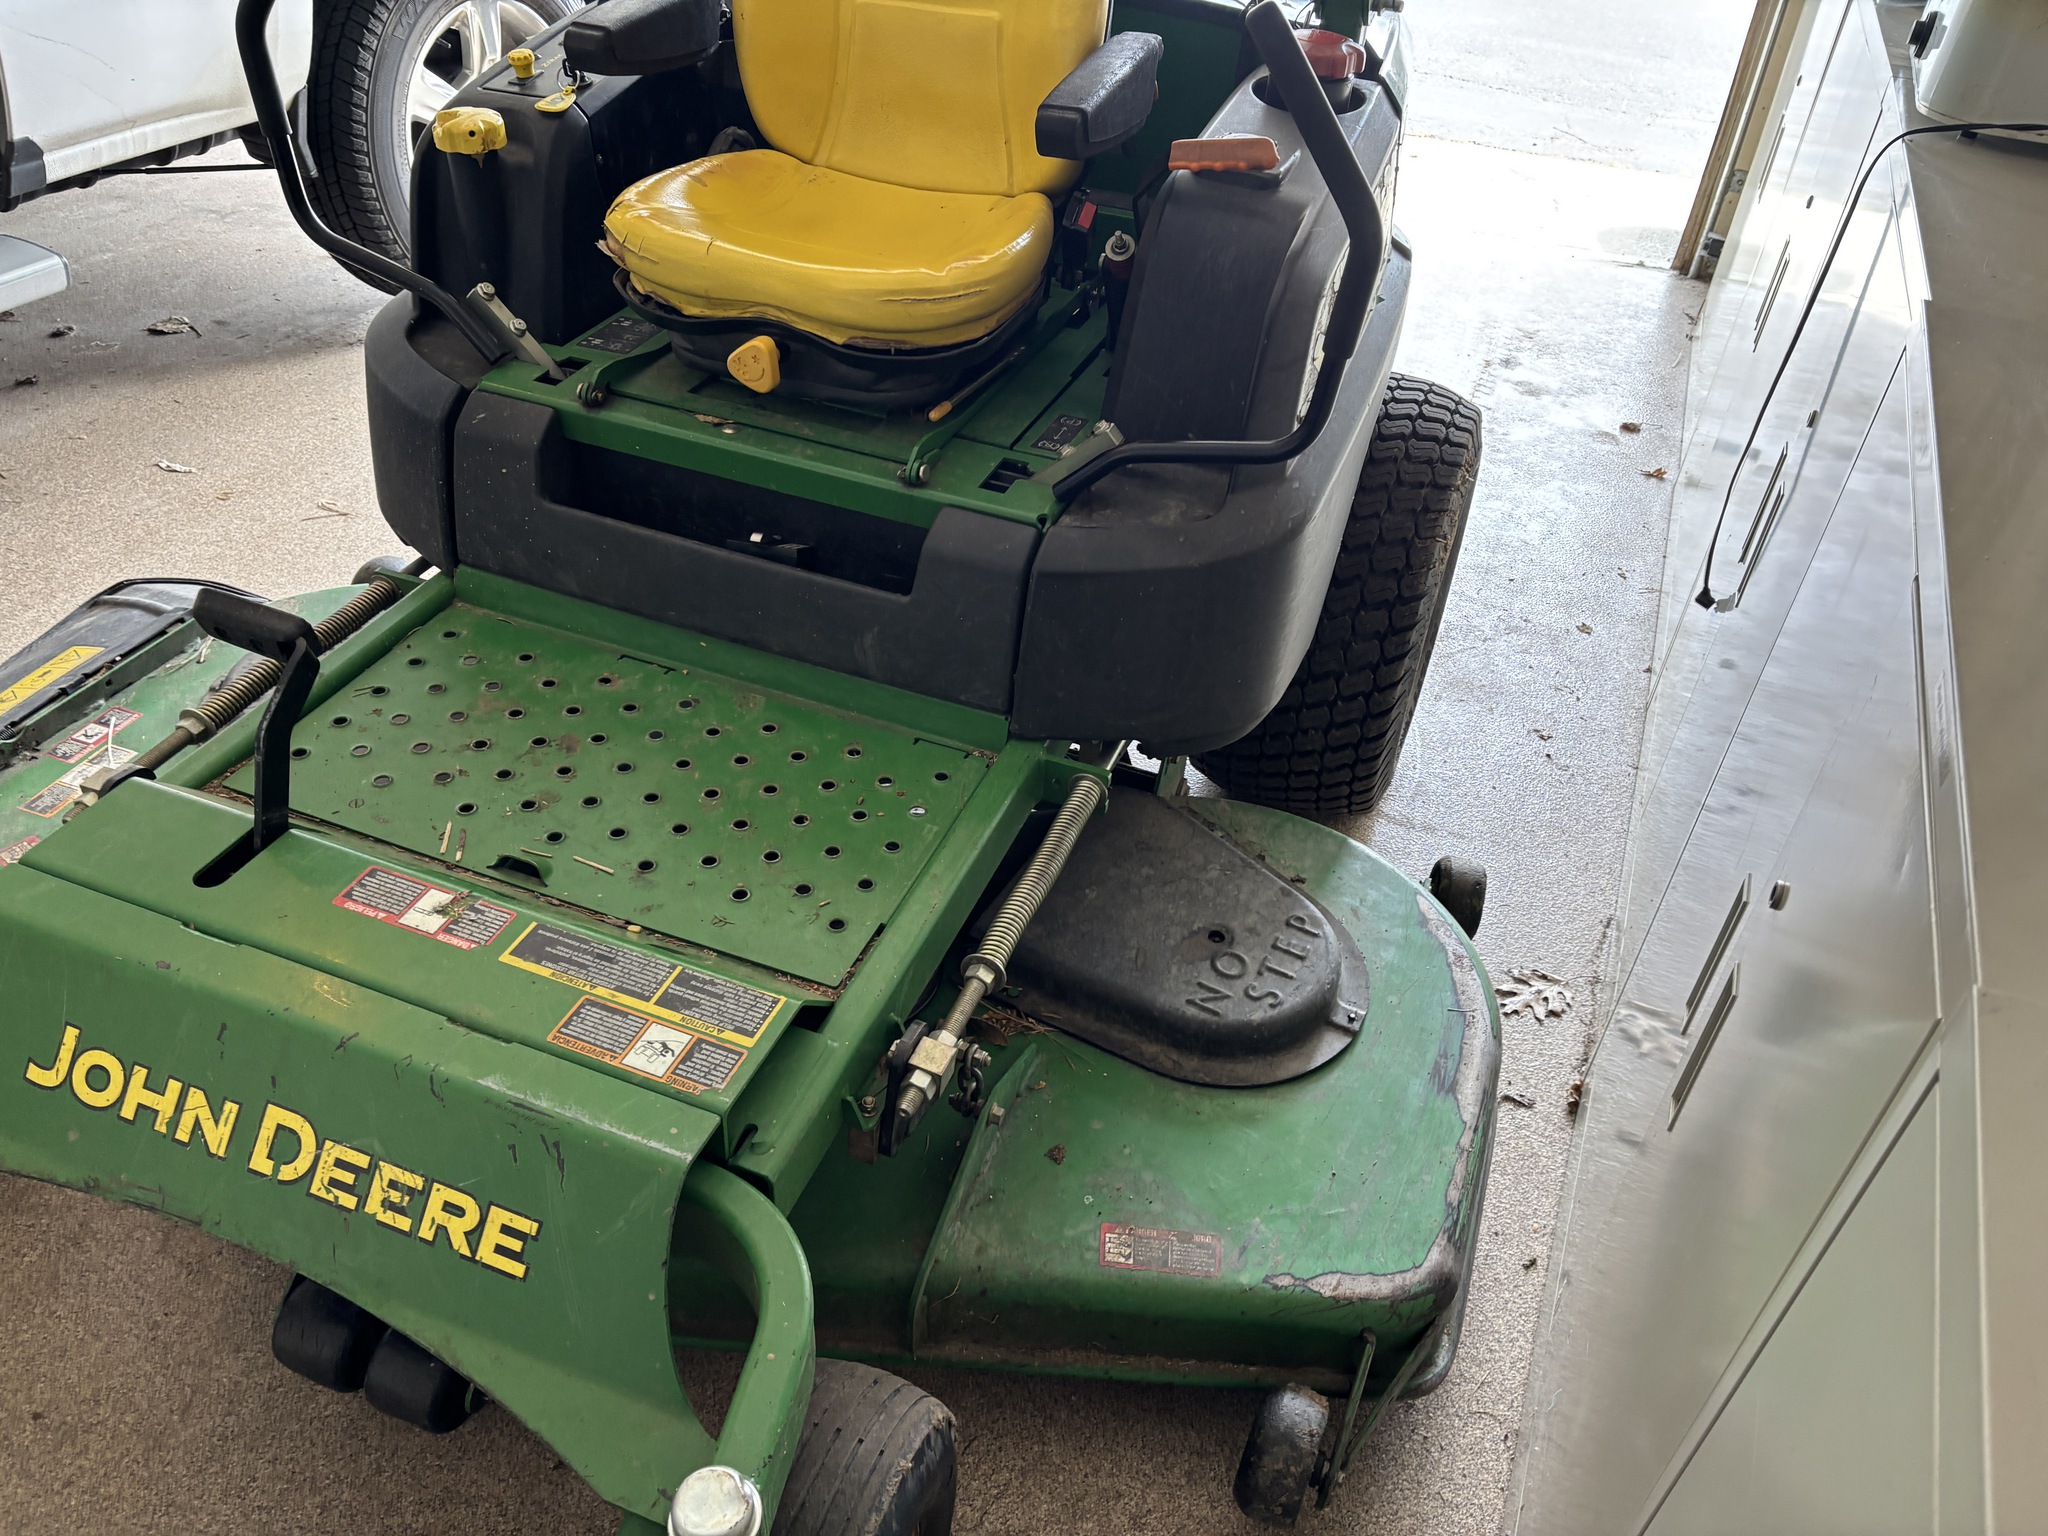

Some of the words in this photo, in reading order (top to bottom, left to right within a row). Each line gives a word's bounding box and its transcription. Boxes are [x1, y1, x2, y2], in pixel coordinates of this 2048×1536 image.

[342, 900, 379, 916] PELIGRO
[435, 933, 471, 948] DANGER
[1245, 914, 1323, 1008] STEP
[1186, 950, 1249, 1017] NO
[678, 1015, 717, 1033] CAUTION
[549, 1033, 609, 1059] ADVERTENCIA
[23, 1021, 242, 1160] JOHN
[247, 1102, 542, 1280] DEERE
